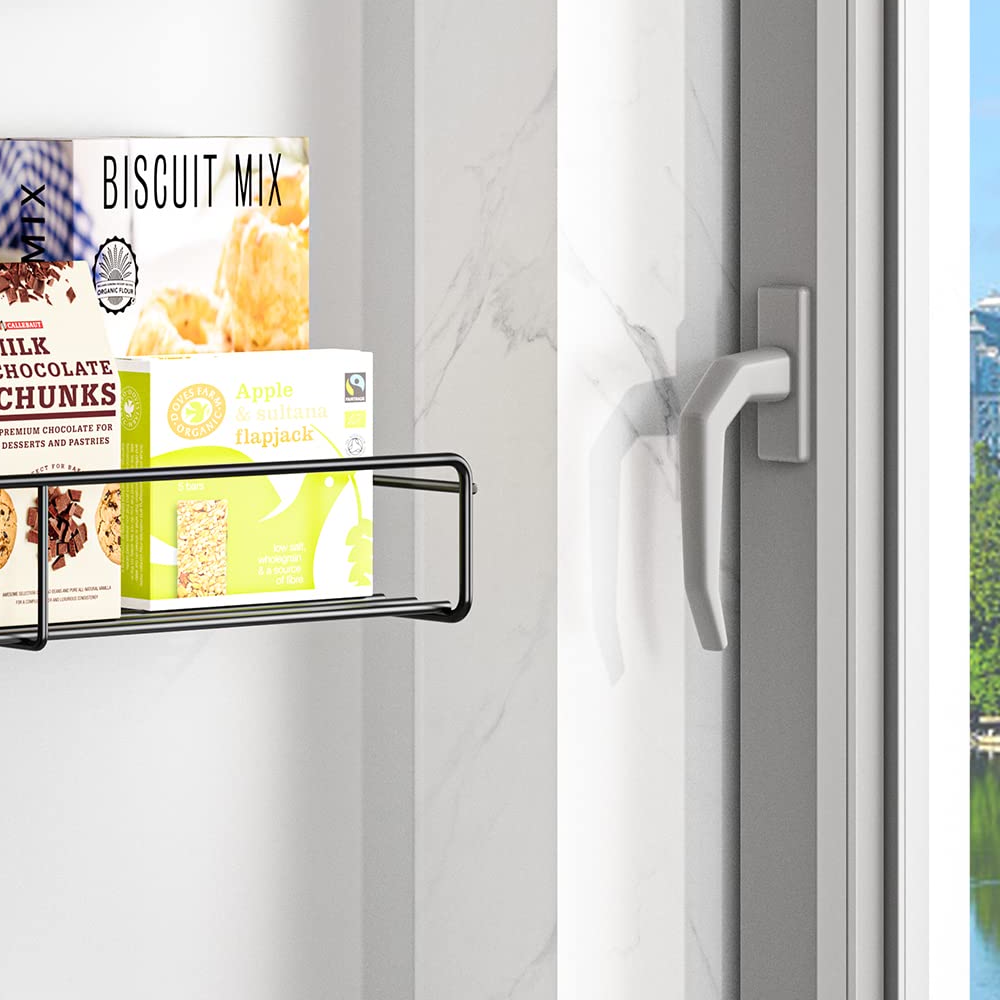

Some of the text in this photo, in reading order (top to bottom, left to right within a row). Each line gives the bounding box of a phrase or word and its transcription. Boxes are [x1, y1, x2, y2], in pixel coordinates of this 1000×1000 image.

[103, 153, 282, 209] BISCUIT MIX
[20, 184, 45, 262] MIX
[7, 321, 42, 329] CALLEBAUT
[235, 382, 293, 403] Apple
[170, 387, 194, 421] DOVES
[197, 386, 222, 407] FARM
[236, 404, 328, 421] & sultana
[42, 424, 94, 434] CHOCOLATE
[176, 412, 222, 437] ORGANIC
[2, 437, 110, 449] DESSERTS AND PASTRIES
[235, 426, 314, 448] flapjack
[185, 482, 205, 491] bars
[273, 543, 288, 553] low
